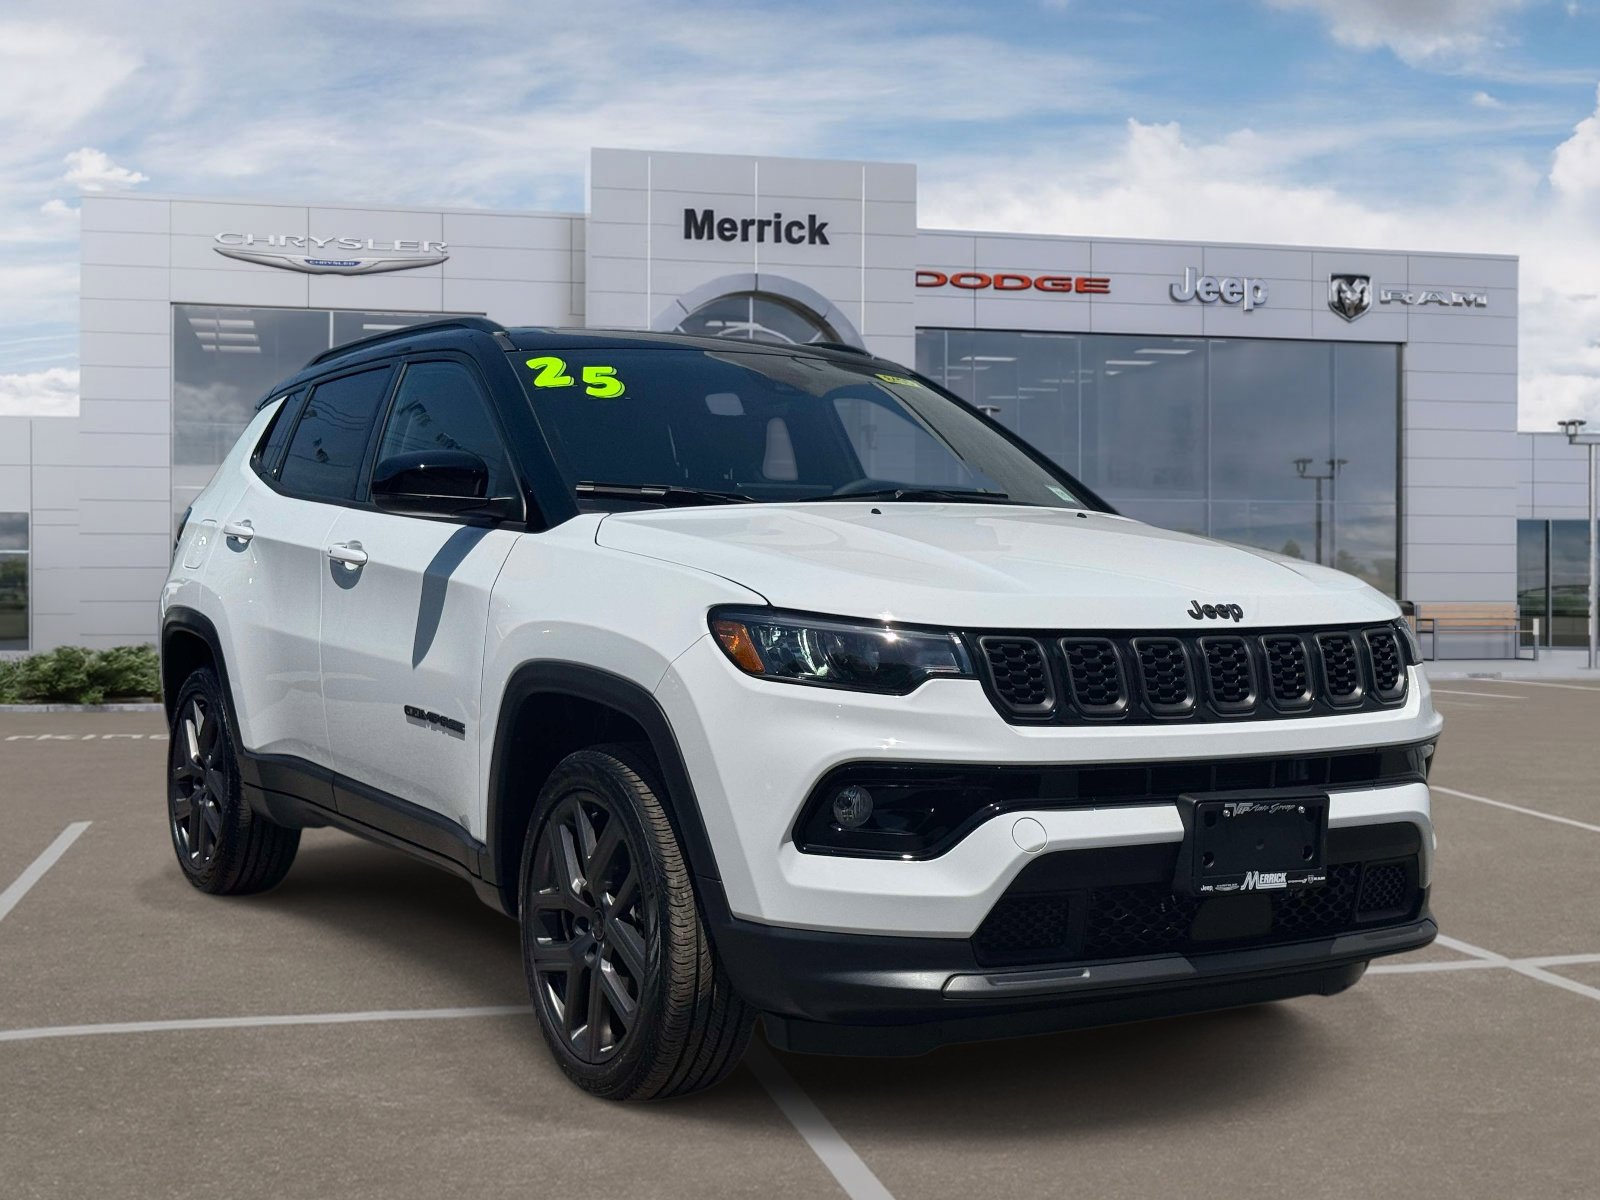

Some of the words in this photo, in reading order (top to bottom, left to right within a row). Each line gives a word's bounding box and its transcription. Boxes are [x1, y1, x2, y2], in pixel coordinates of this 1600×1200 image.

[684, 208, 830, 245] Merrick
[213, 232, 449, 253] CHRYSLER
[915, 271, 1111, 294] DODGE
[1169, 267, 1268, 311] Jeep
[1380, 288, 1487, 307] RAM
[1187, 599, 1244, 622] Jeep
